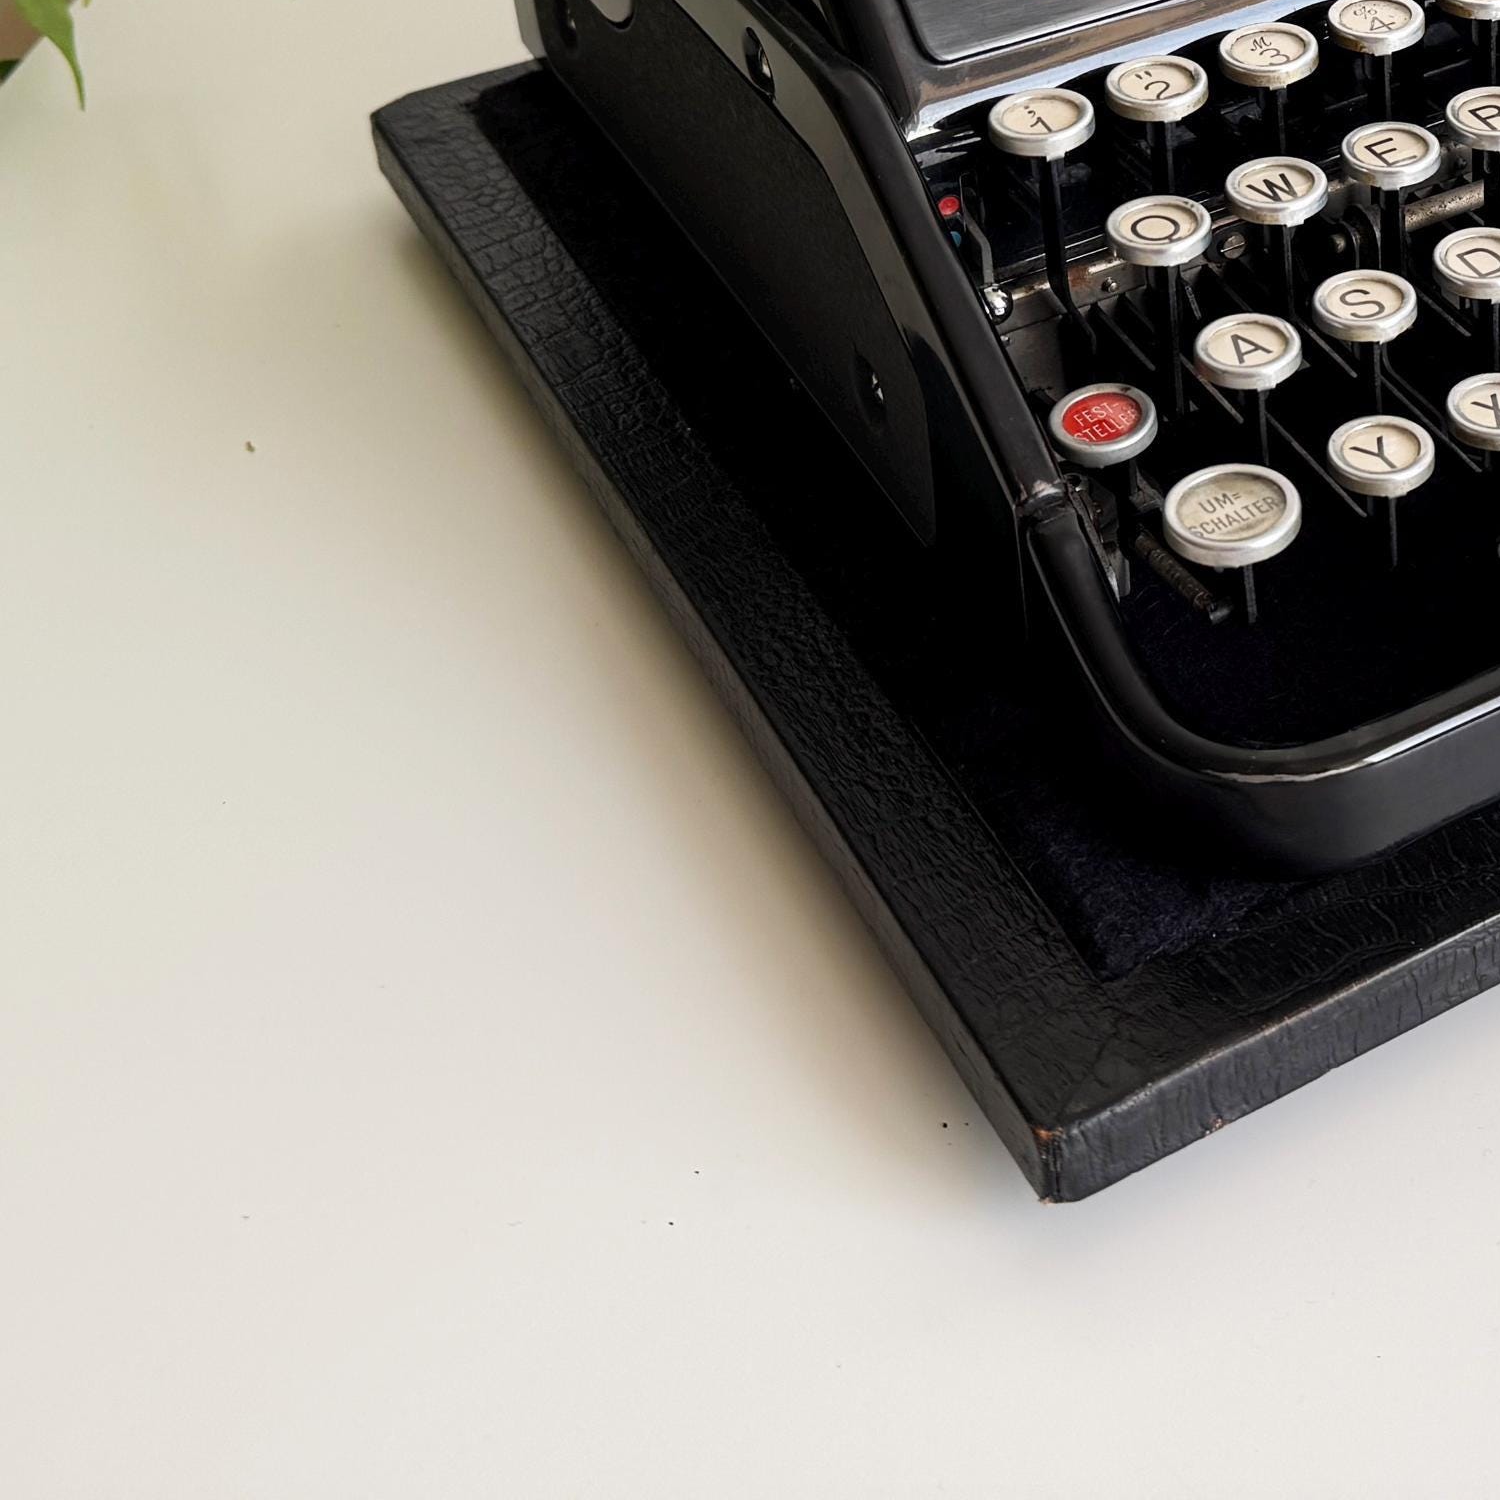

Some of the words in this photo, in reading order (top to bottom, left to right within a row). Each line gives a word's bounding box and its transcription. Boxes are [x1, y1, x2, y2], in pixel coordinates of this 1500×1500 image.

[1370, 16, 1396, 31] 4
[1259, 48, 1290, 66] 3
[1144, 80, 1171, 100] 2
[1363, 137, 1418, 166] E
[1245, 173, 1298, 202] W
[1130, 215, 1181, 244] Q
[1339, 288, 1386, 319] S
[1230, 333, 1274, 365] A
[1073, 401, 1119, 427] FEST-
[1348, 435, 1398, 469] Y
